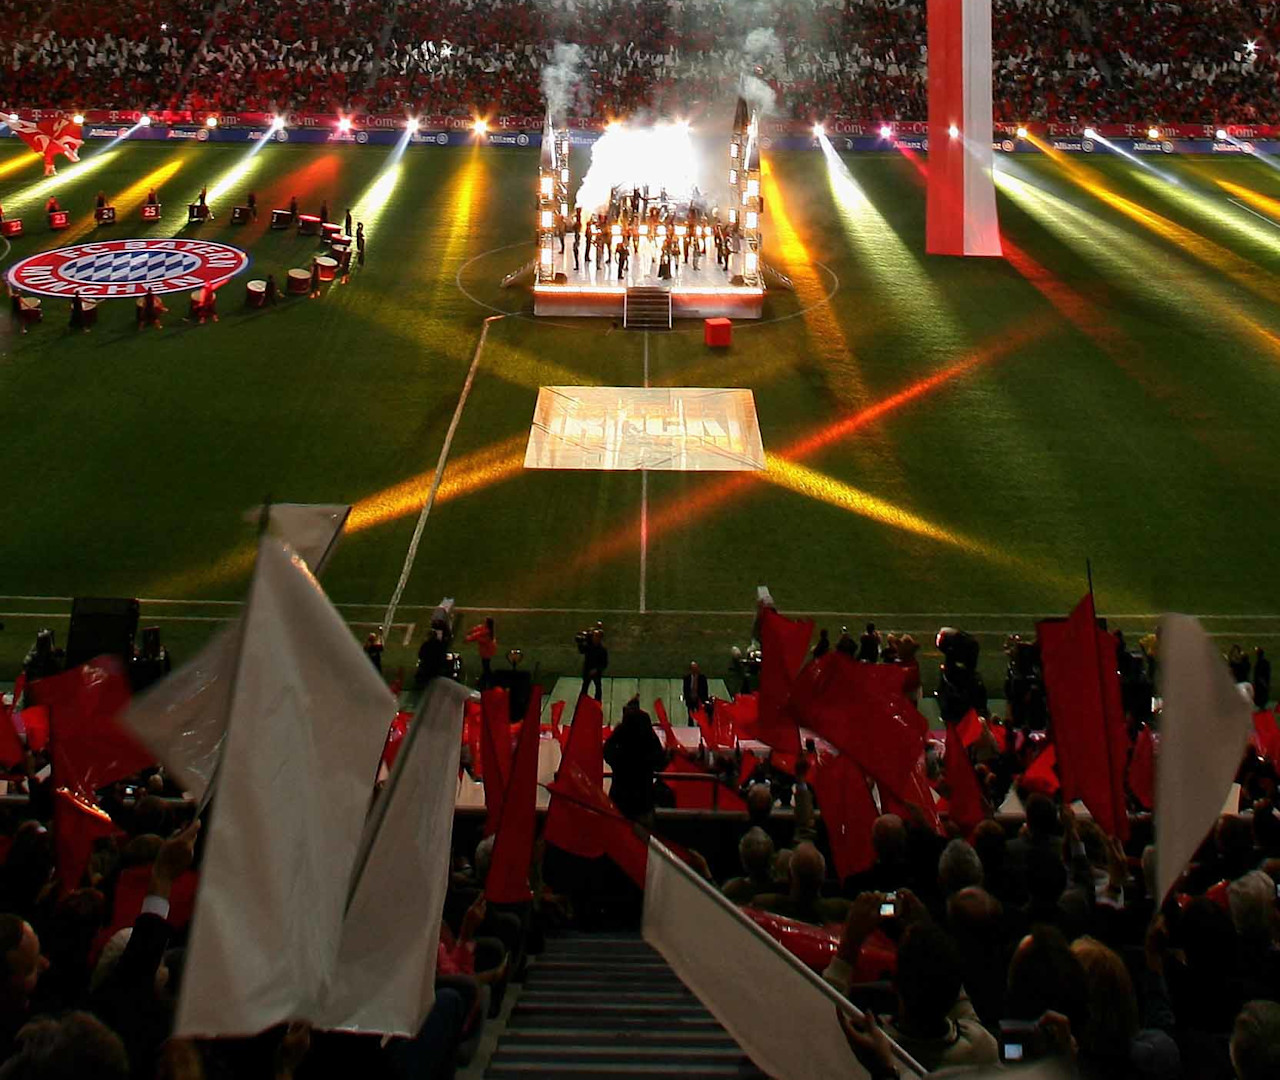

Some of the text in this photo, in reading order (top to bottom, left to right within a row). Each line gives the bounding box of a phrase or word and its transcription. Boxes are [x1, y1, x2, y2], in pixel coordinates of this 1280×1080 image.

[89, 128, 118, 138] Allianz
[168, 129, 197, 139] Allianz
[247, 131, 275, 140] Allianz
[488, 135, 516, 144] Allianz
[1053, 141, 1082, 151] Allianz
[1133, 142, 1162, 152] Allianz
[1212, 142, 1241, 152] Allianz
[102, 208, 114, 219] 24
[144, 207, 156, 217] 25
[54, 213, 66, 224] 23
[11, 222, 23, 233] 22
[58, 241, 238, 270] FC BAYERN
[20, 265, 205, 296] MÜNCHEN
